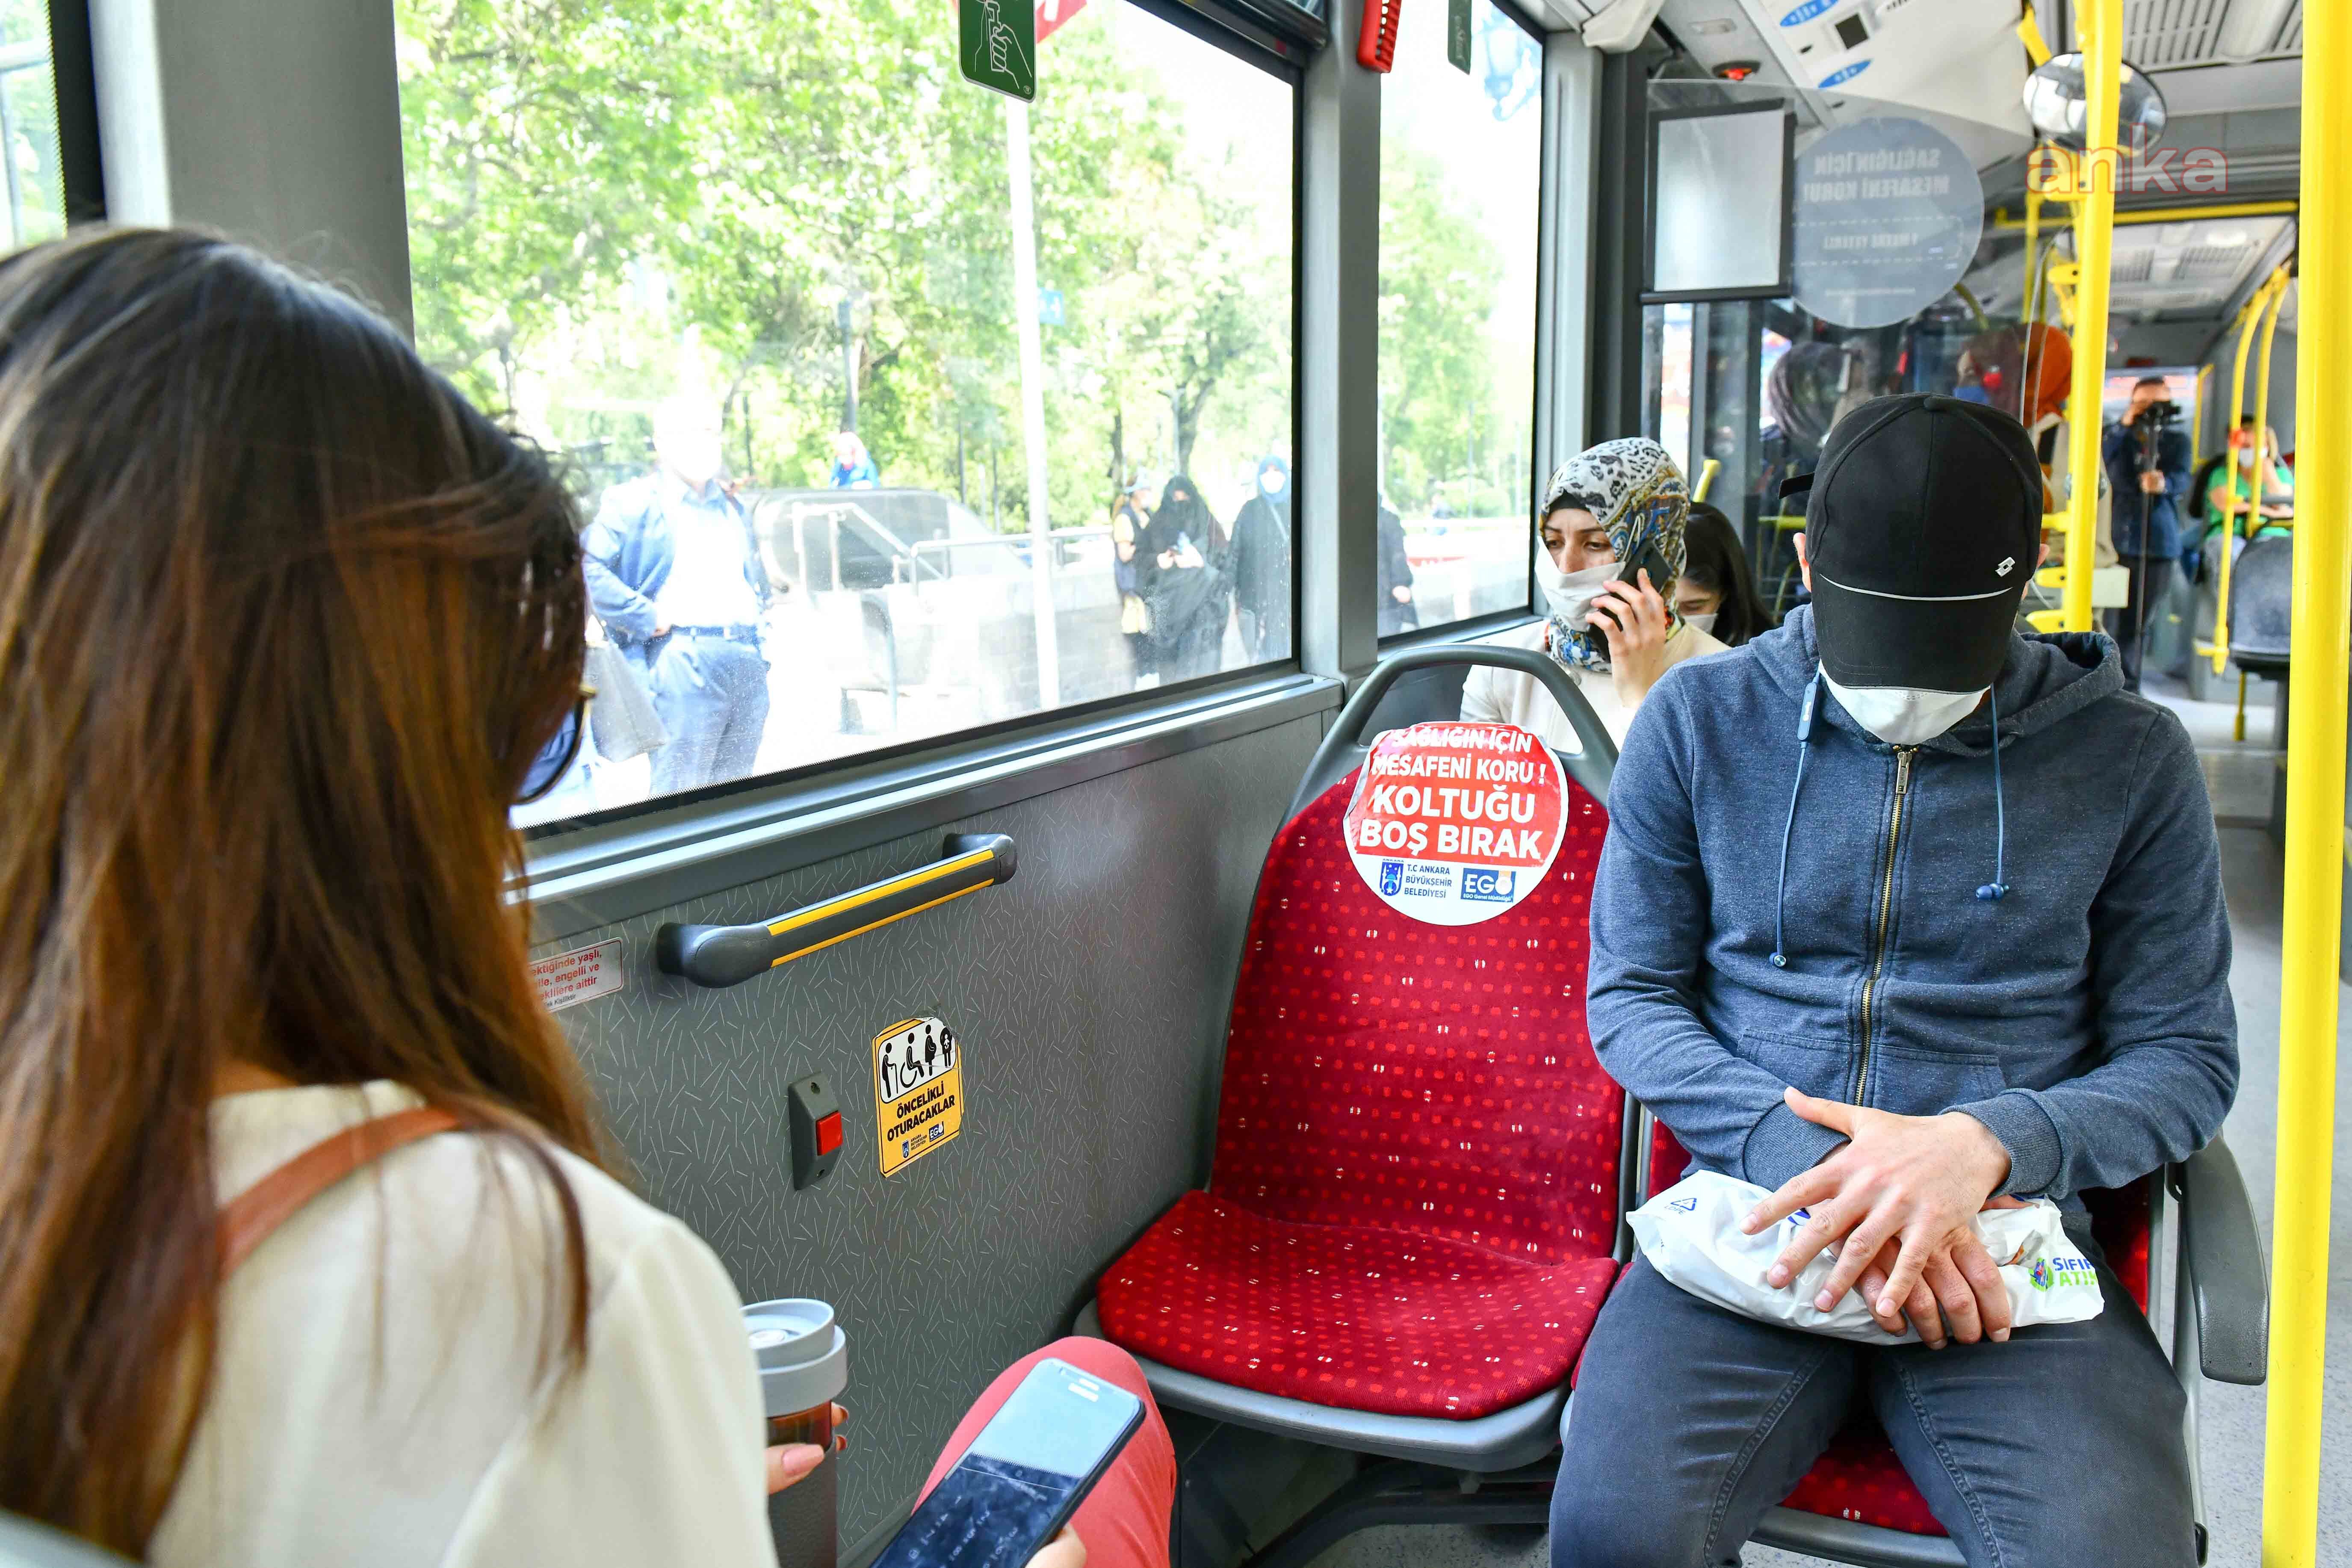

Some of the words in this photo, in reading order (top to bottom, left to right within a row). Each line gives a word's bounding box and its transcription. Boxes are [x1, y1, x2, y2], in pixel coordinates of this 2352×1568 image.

[1392, 726, 1483, 748] SAĞLIĞIN
[1489, 728, 1533, 755] İÇİN
[1371, 753, 1471, 779] MESAFENİ
[1476, 758, 1534, 783] KORU
[1372, 783, 1536, 823] KOLTUĞU
[1359, 818, 1428, 856] BOŞ
[1437, 824, 1544, 859] BIRAK
[1405, 875, 1452, 887] BÜYÜKŞEHİR
[1407, 864, 1418, 872] T.C
[1419, 865, 1451, 875] ANKARA
[1404, 887, 1446, 898] BELEDİYESİ
[1465, 873, 1513, 895] EGO
[532, 957, 575, 976] ektiğinde
[578, 949, 602, 965] yaşlı,
[538, 977, 553, 988] ile,
[555, 966, 586, 983] engelli
[589, 963, 600, 972] ve
[576, 976, 597, 989] aittir
[896, 1081, 945, 1119] ÖNCELİKLİ
[886, 1094, 955, 1141] OTURACAKLAR
